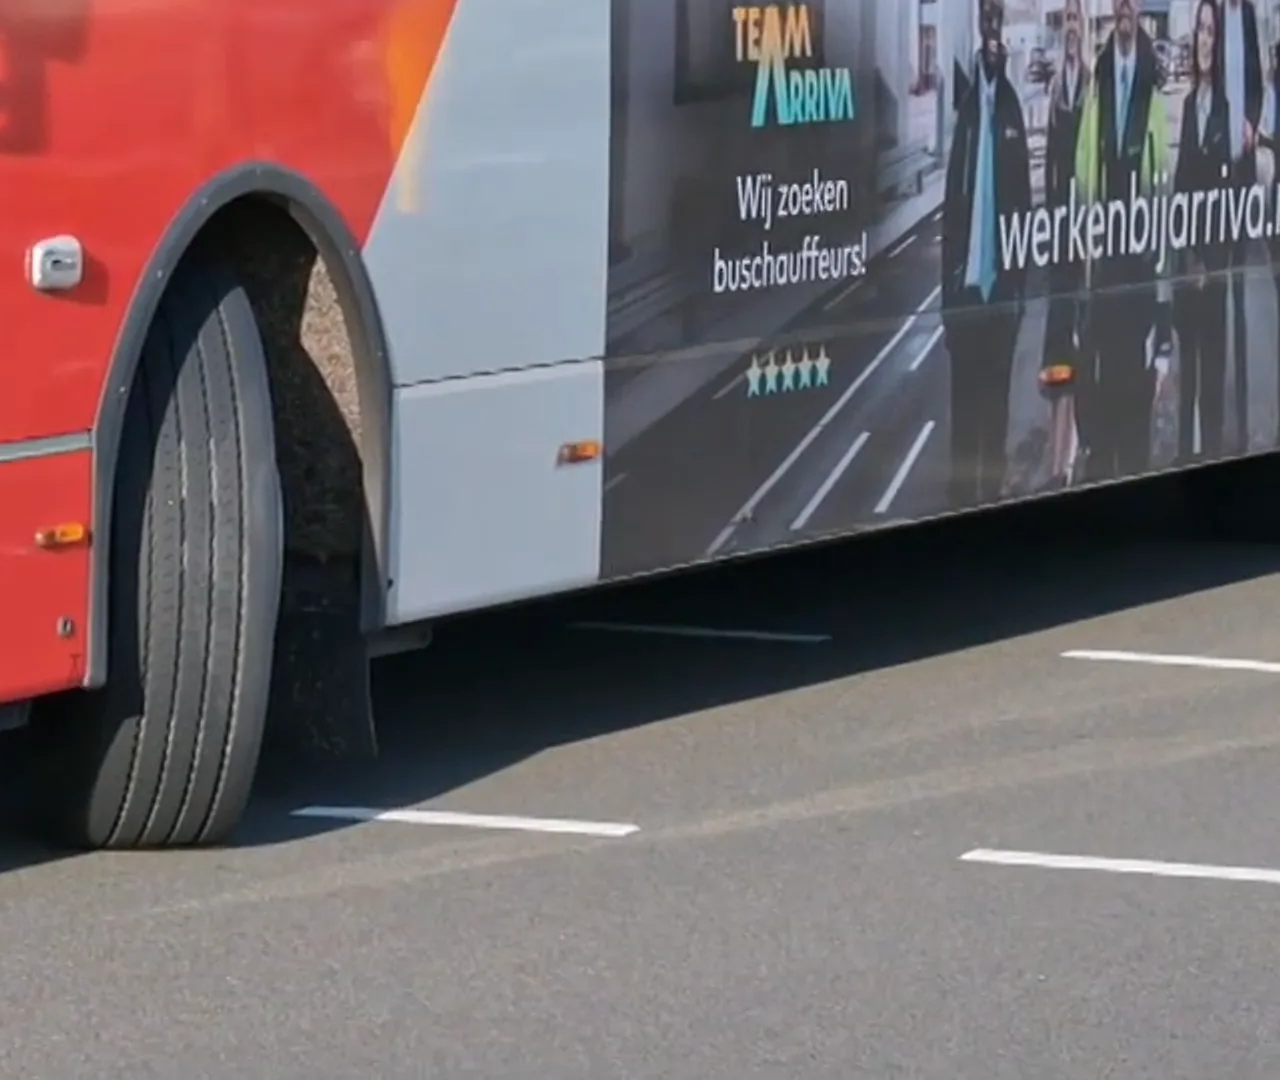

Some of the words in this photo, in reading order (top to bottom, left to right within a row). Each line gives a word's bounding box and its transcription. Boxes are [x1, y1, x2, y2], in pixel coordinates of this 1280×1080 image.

[732, 4, 812, 62] TEAM
[736, 173, 772, 231] Wij
[777, 168, 848, 216] zoeken
[999, 163, 1280, 274] werkenbijarriva.
[713, 230, 868, 293] buschauffeurs!
